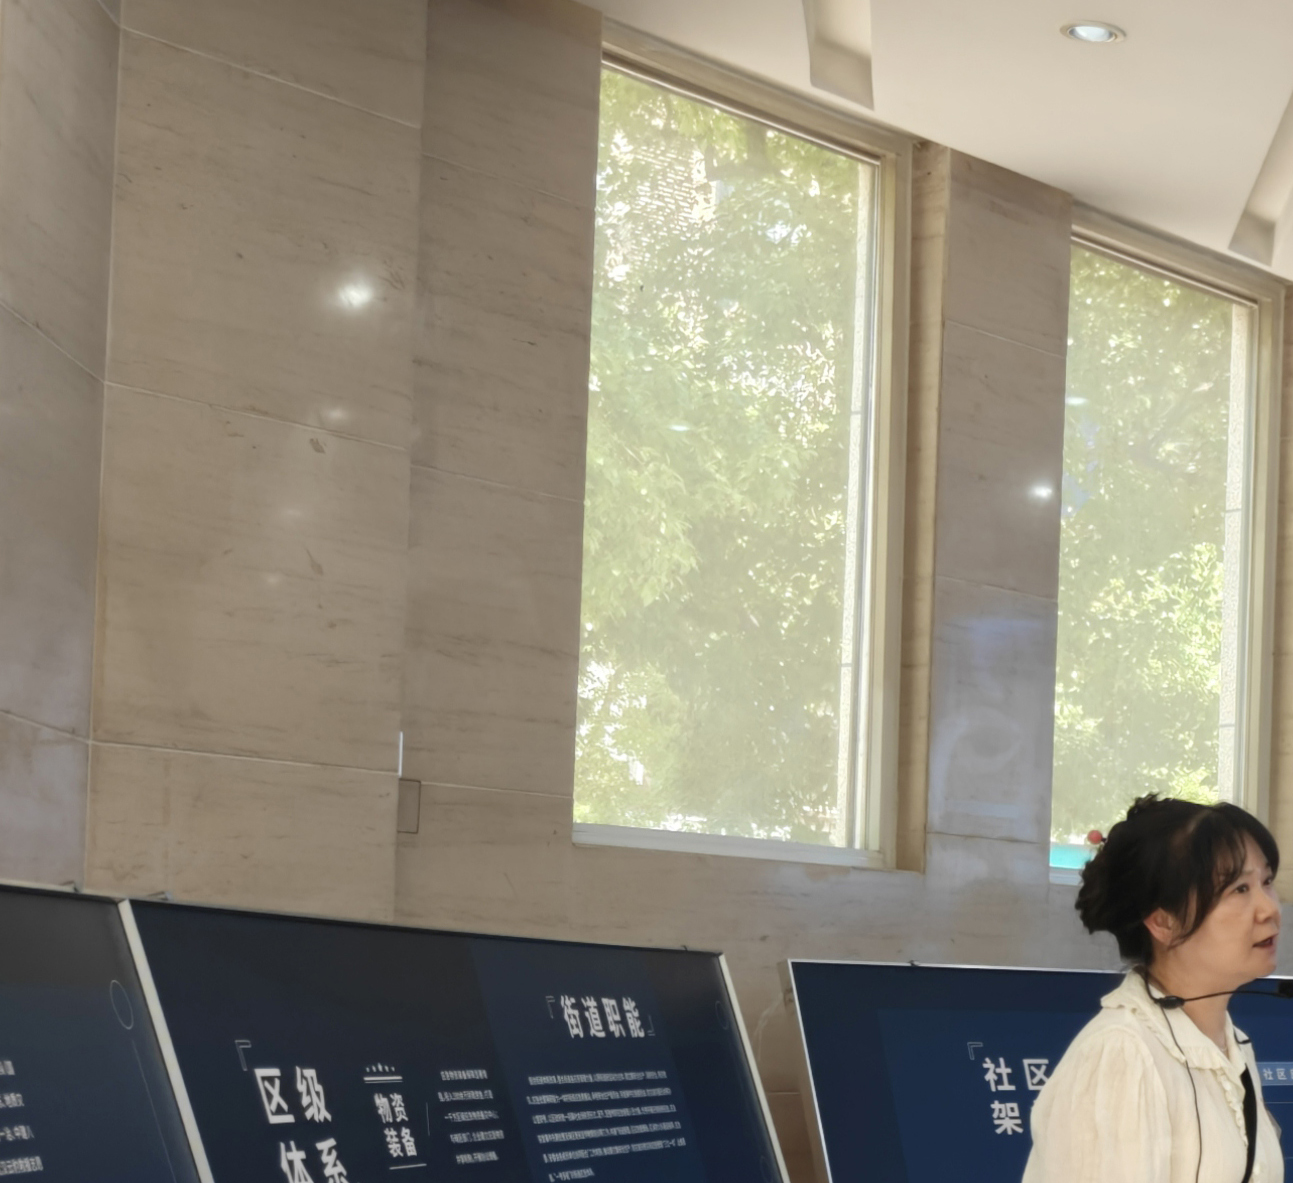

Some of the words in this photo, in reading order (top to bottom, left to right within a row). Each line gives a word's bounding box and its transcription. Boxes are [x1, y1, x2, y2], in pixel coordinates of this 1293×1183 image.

[559, 995, 646, 1039] 街道职能
[982, 1057, 1050, 1092] 社区
[254, 1066, 332, 1124] 区级
[373, 1093, 409, 1124] 物资
[990, 1100, 1024, 1135] 架
[383, 1126, 418, 1157] 装备
